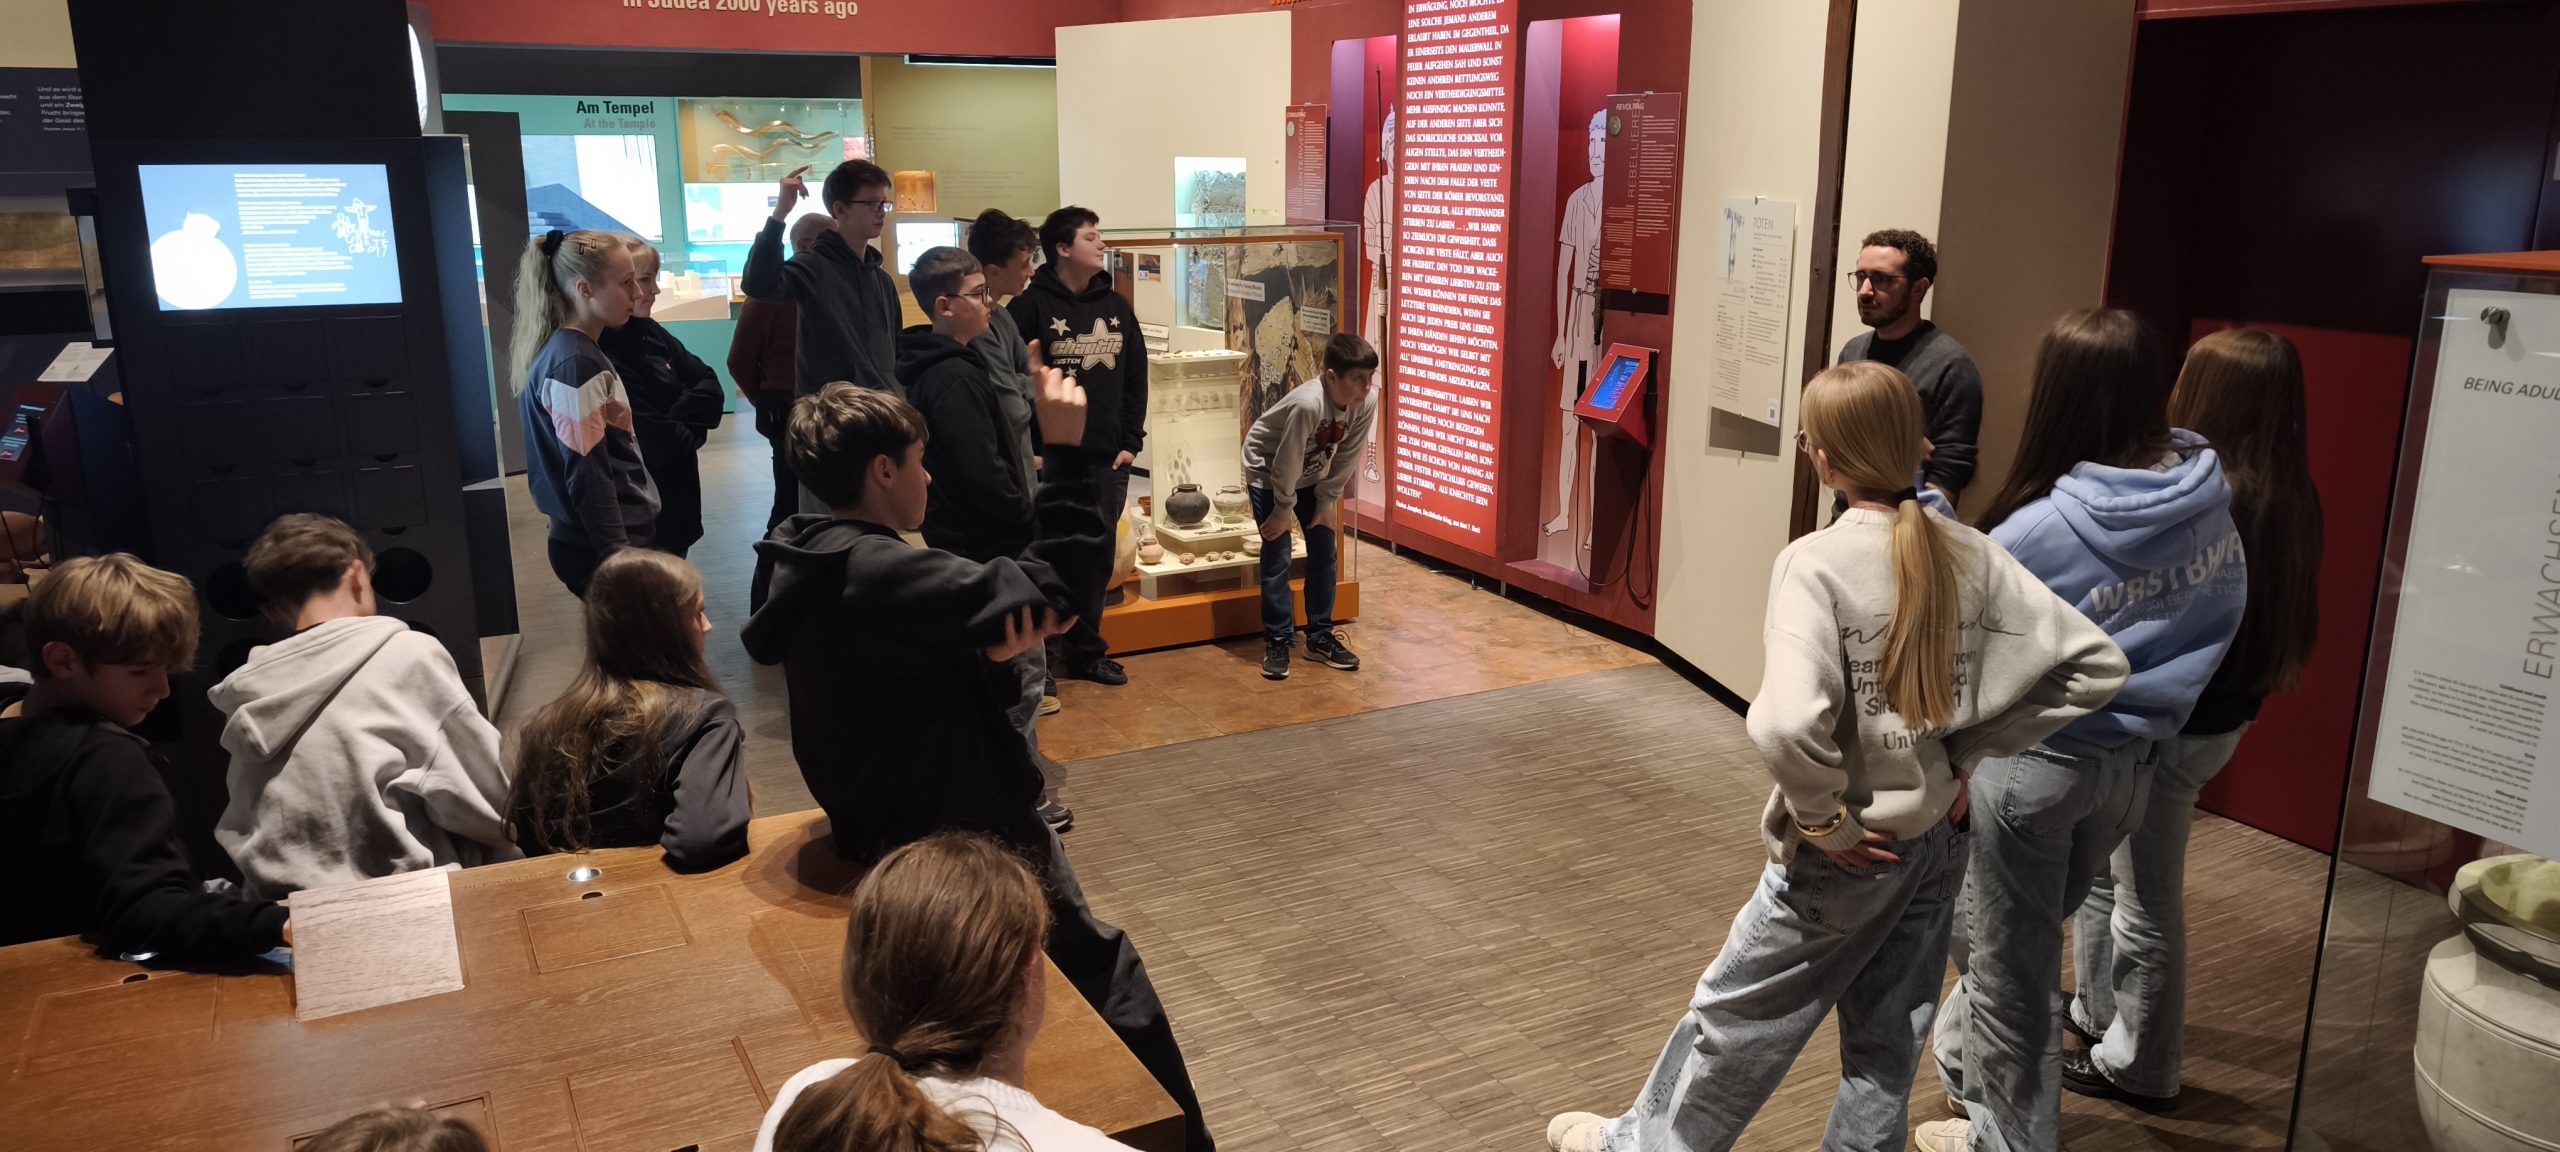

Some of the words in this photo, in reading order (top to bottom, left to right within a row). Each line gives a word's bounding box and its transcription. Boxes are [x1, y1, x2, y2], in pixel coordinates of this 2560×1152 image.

[716, 0, 760, 11] 2000
[766, 0, 818, 16] years
[824, 1, 858, 19] ago
[576, 100, 599, 114] Am
[603, 100, 654, 117] Tempel
[584, 118, 596, 128] At
[598, 118, 614, 128] the
[1050, 338, 1122, 356] chaotic
[2464, 377, 2514, 394] BEING
[2516, 384, 2560, 400] ADUL
